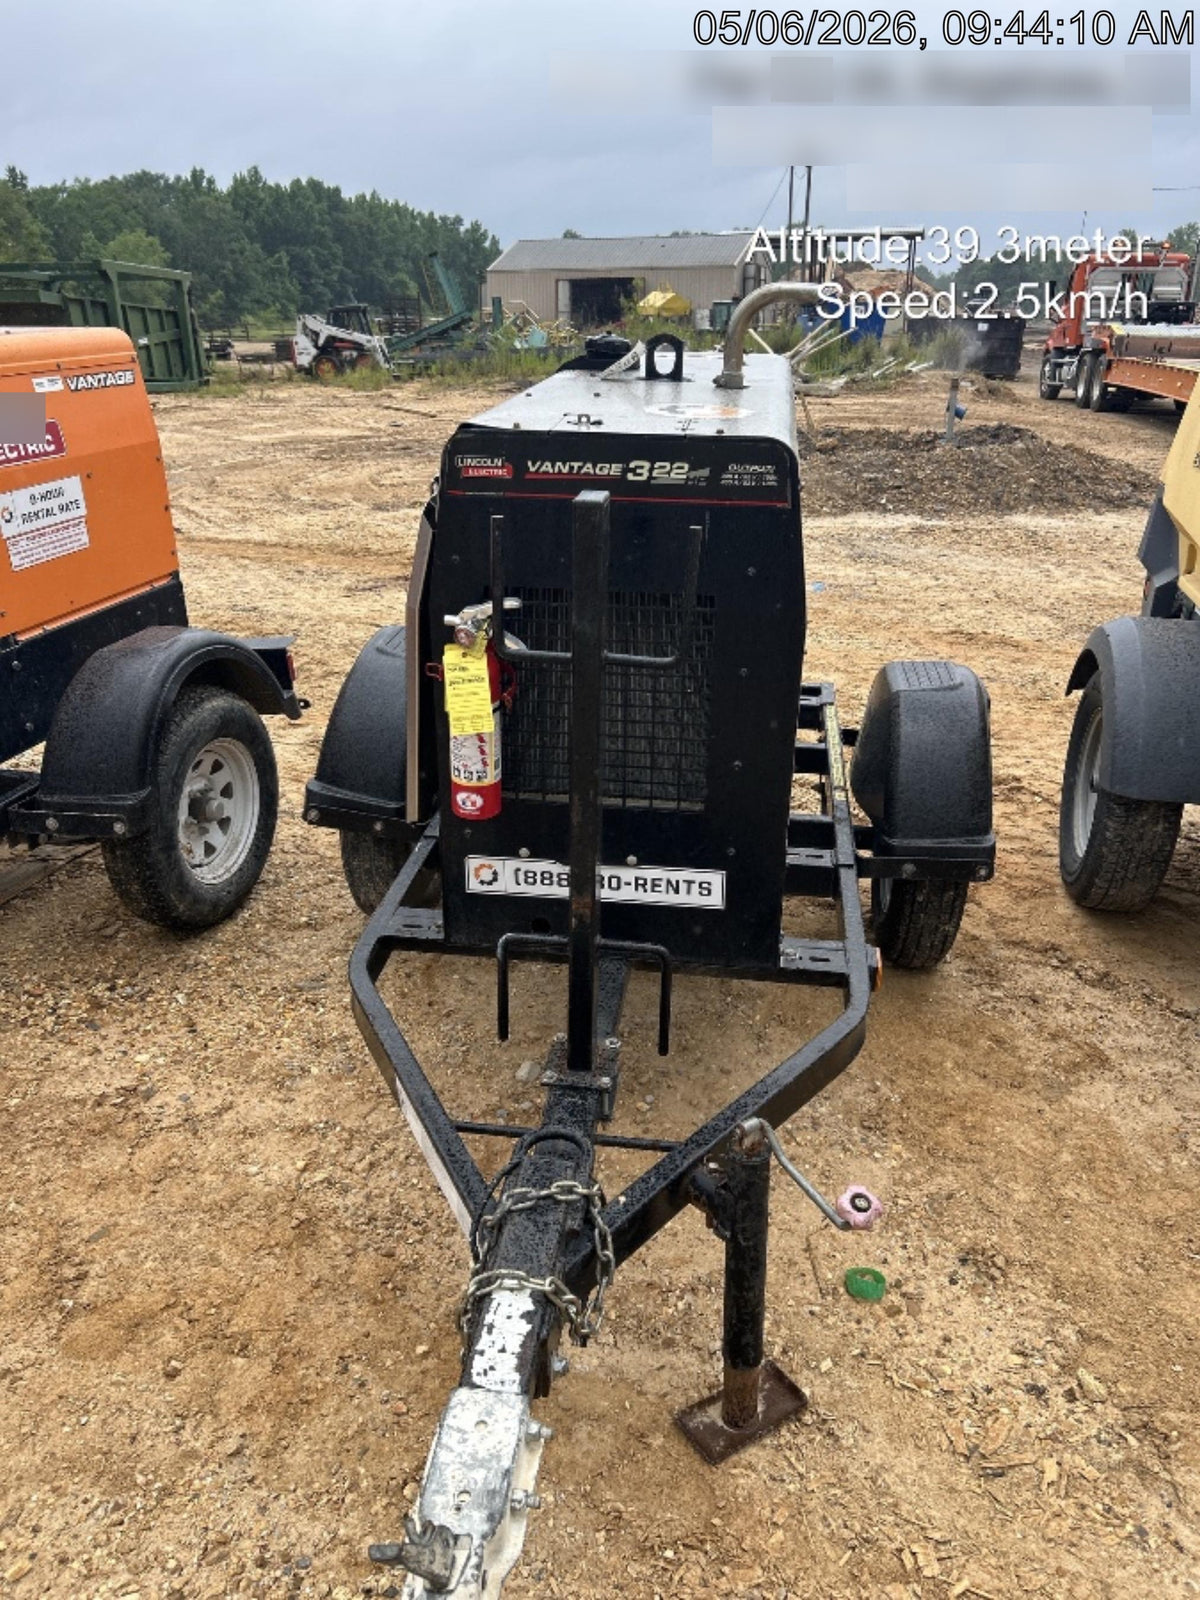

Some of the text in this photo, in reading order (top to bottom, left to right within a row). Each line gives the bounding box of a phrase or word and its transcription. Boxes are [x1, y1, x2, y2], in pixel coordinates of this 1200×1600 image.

[66, 370, 135, 391] VANTAGE
[457, 457, 503, 467] LINCOLN
[527, 460, 623, 476] VANTAGE
[627, 460, 689, 481] 322
[21, 498, 81, 525] RENTAL RATE
